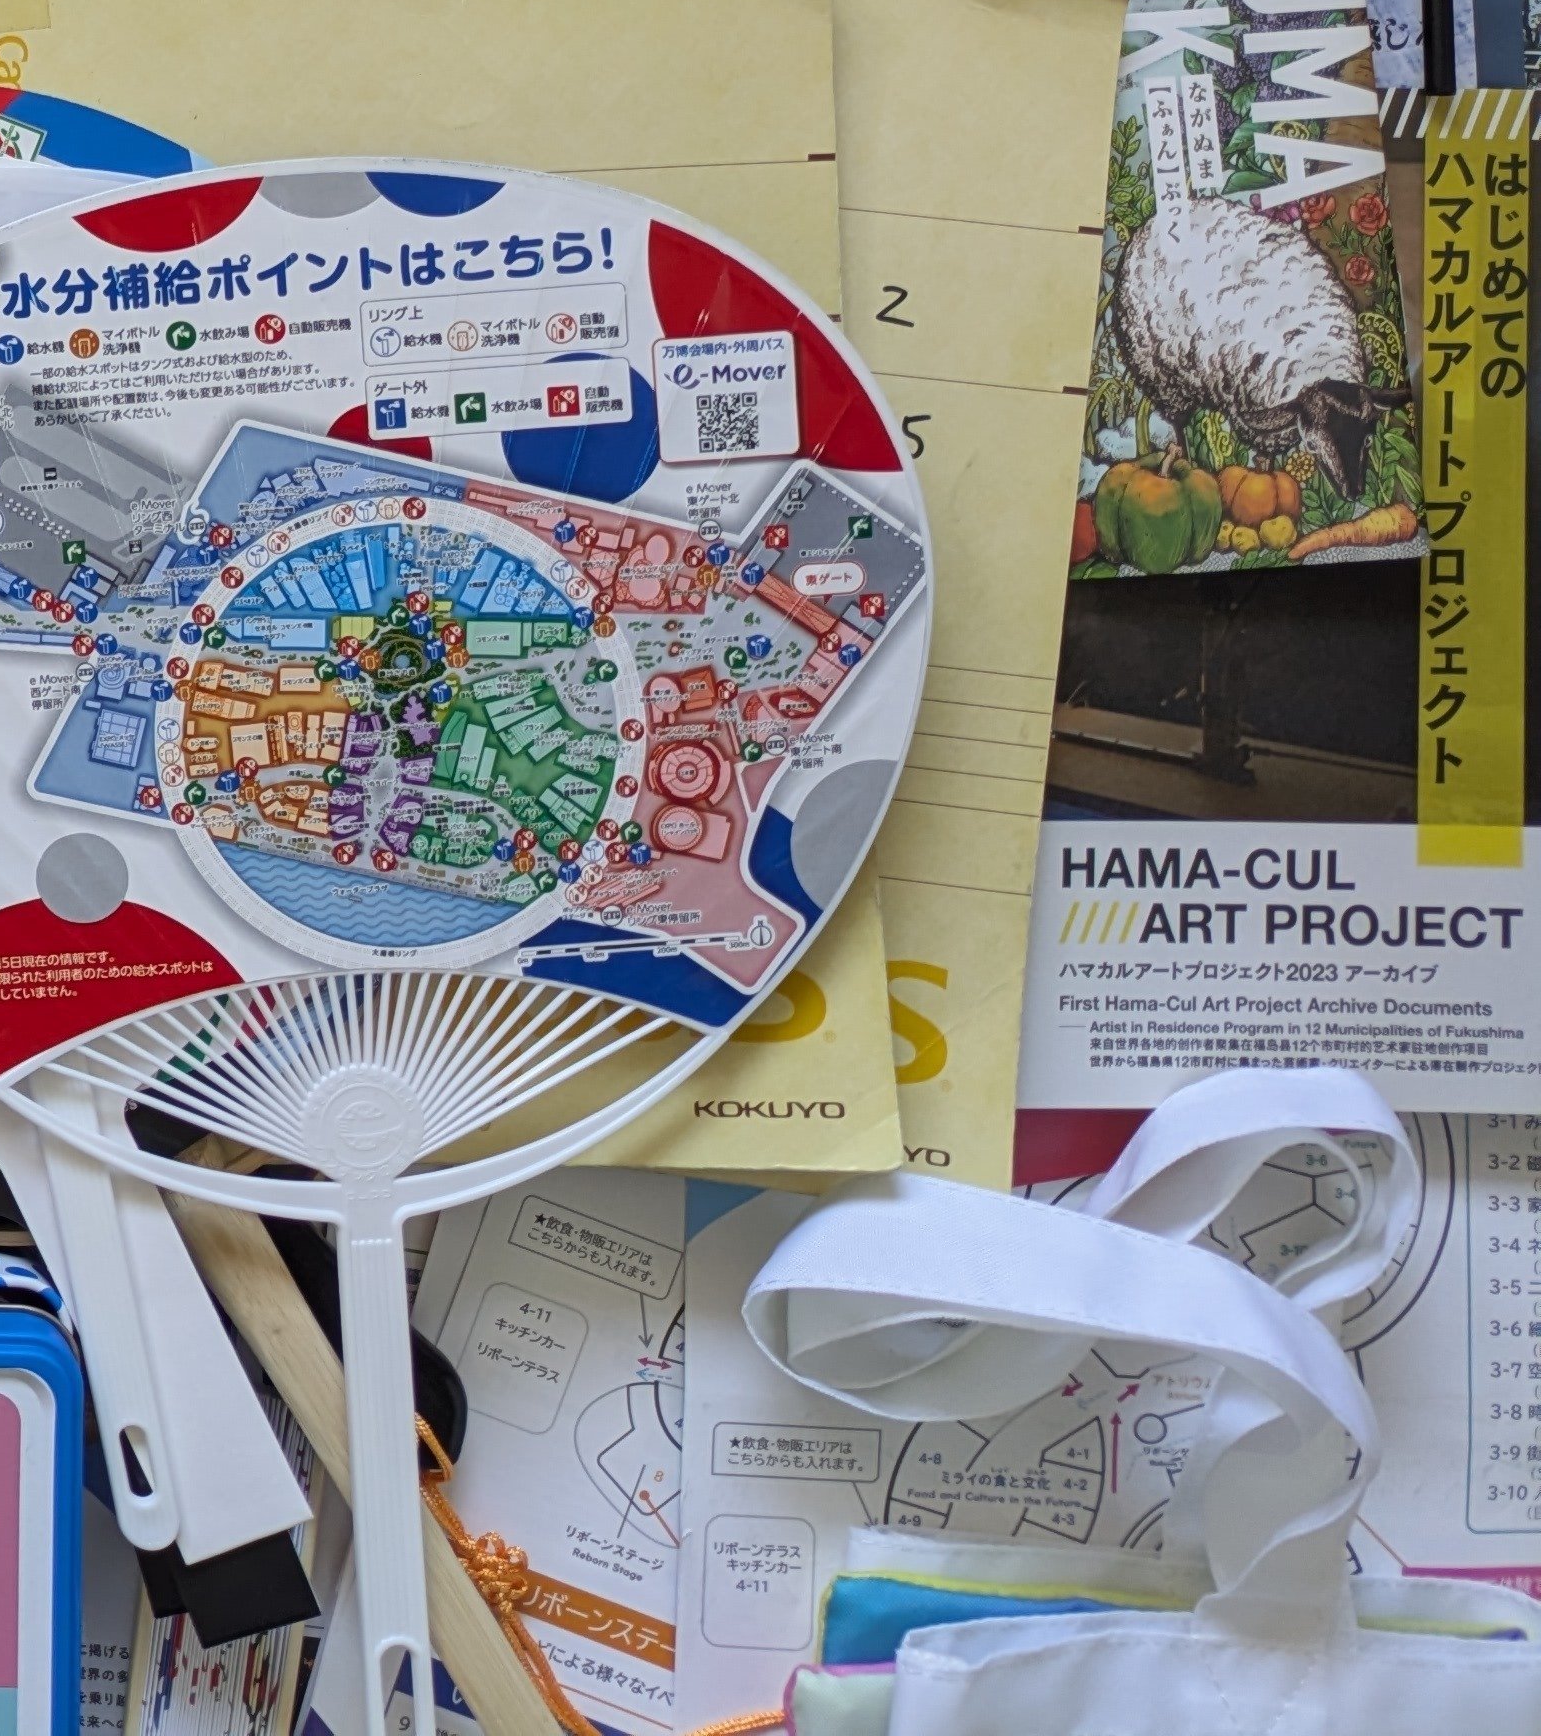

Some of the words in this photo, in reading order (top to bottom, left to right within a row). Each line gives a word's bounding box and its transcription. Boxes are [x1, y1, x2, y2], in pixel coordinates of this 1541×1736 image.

[1186, 79, 1219, 180] ながぬま
[1480, 151, 1530, 401] はじめての
[368, 305, 424, 324] リング上
[199, 323, 250, 342] 水飲み場
[373, 378, 429, 397] ゲート外
[491, 396, 543, 414] 水飲み場
[1421, 151, 1476, 786] ハマカルアートプロジェクト
[1061, 846, 1357, 892] HAMA-CUL
[1138, 902, 1248, 946] ART
[1265, 905, 1524, 950] PROJECT
[1058, 961, 1339, 984] ハマカルアートプロジェクト2023
[1344, 963, 1440, 985] アーカイブ
[1058, 995, 1100, 1013] First
[1104, 996, 1198, 1012] Hama-Cul
[1203, 997, 1231, 1012] Art
[1235, 997, 1303, 1016] Project
[1306, 998, 1379, 1015] Archive
[1383, 999, 1493, 1018] Documents
[693, 1099, 846, 1120] KOKUYO
[1488, 1196, 1521, 1212] 3-3
[1488, 1238, 1522, 1253] 3-4
[1488, 1279, 1522, 1295] 3-5
[1489, 1321, 1522, 1337] 3-6
[1489, 1362, 1522, 1378] 3-7
[726, 1451, 866, 1474] こちらからも入れます。
[712, 1540, 802, 1560] リボーンテラス
[725, 1557, 802, 1576] キッチンカー
[734, 1578, 770, 1593] 4-11
